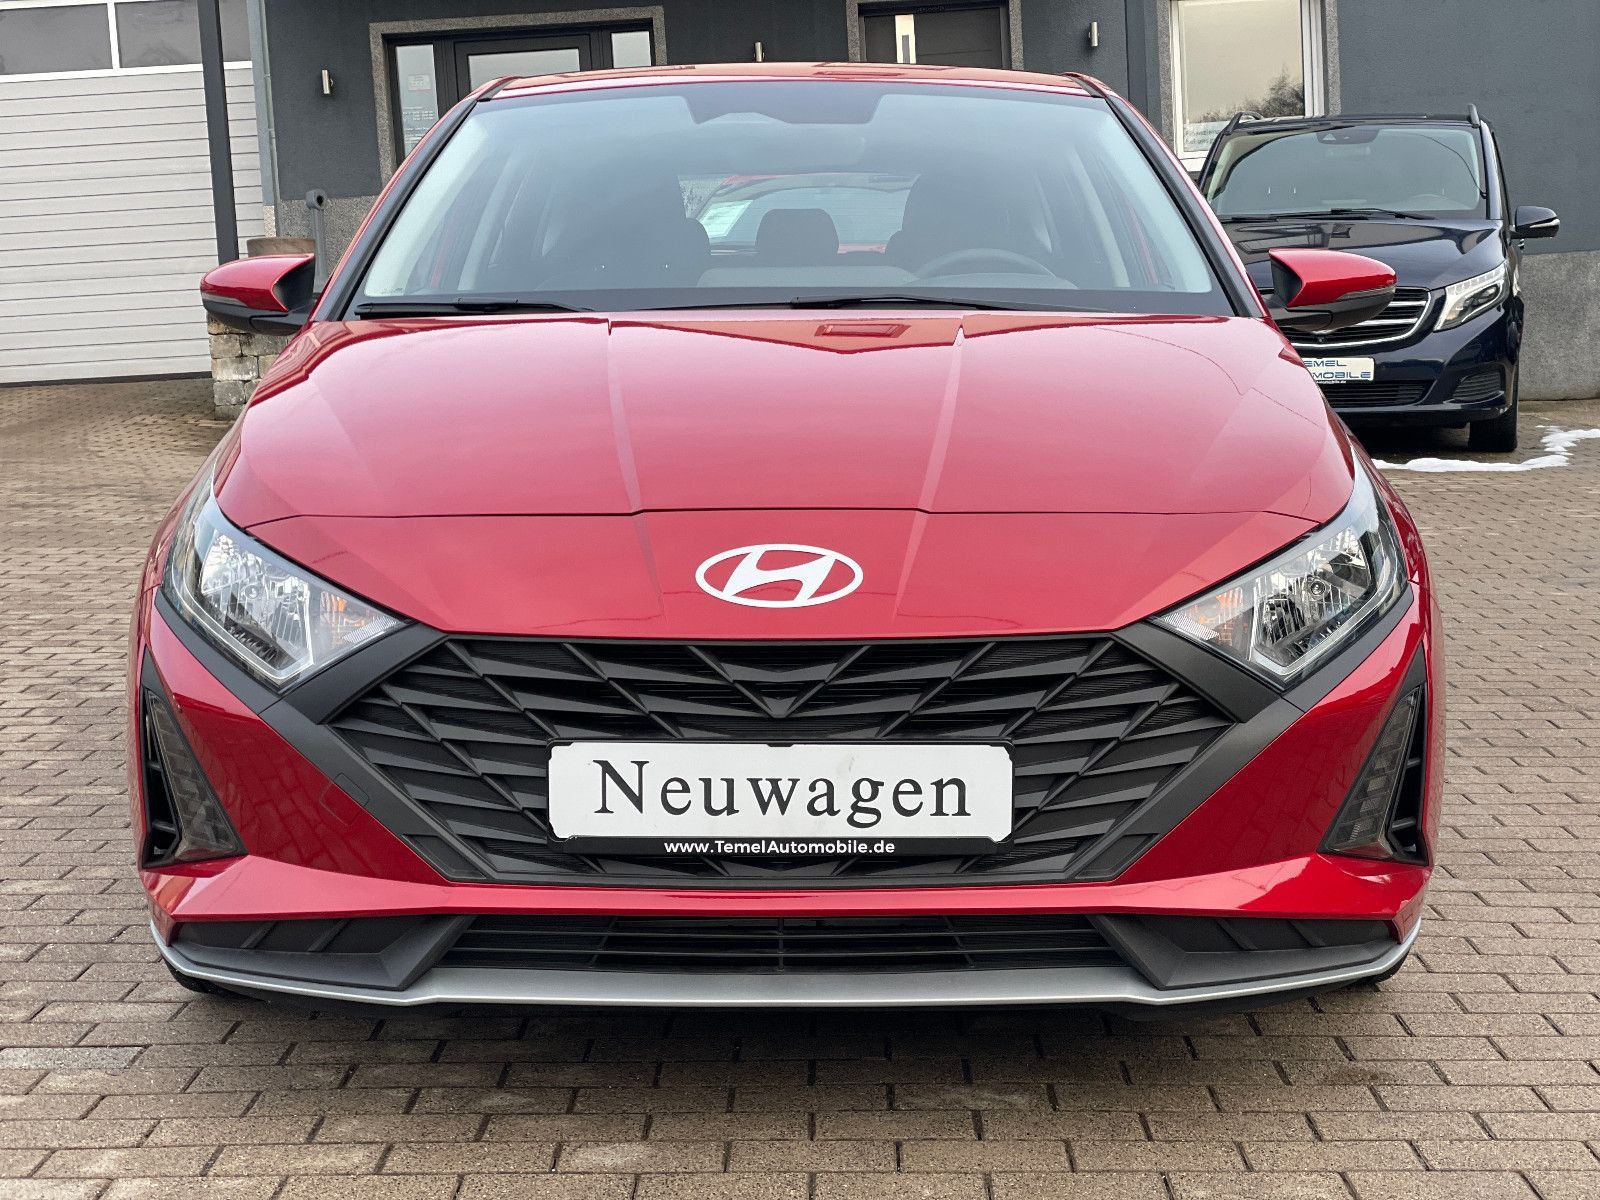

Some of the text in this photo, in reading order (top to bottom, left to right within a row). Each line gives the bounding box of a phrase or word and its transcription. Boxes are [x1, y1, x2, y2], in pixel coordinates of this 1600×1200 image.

[1312, 371, 1371, 379] MOBILE
[593, 759, 972, 828] Neuwagen
[664, 840, 895, 854] www.TemelAutomobile.de
